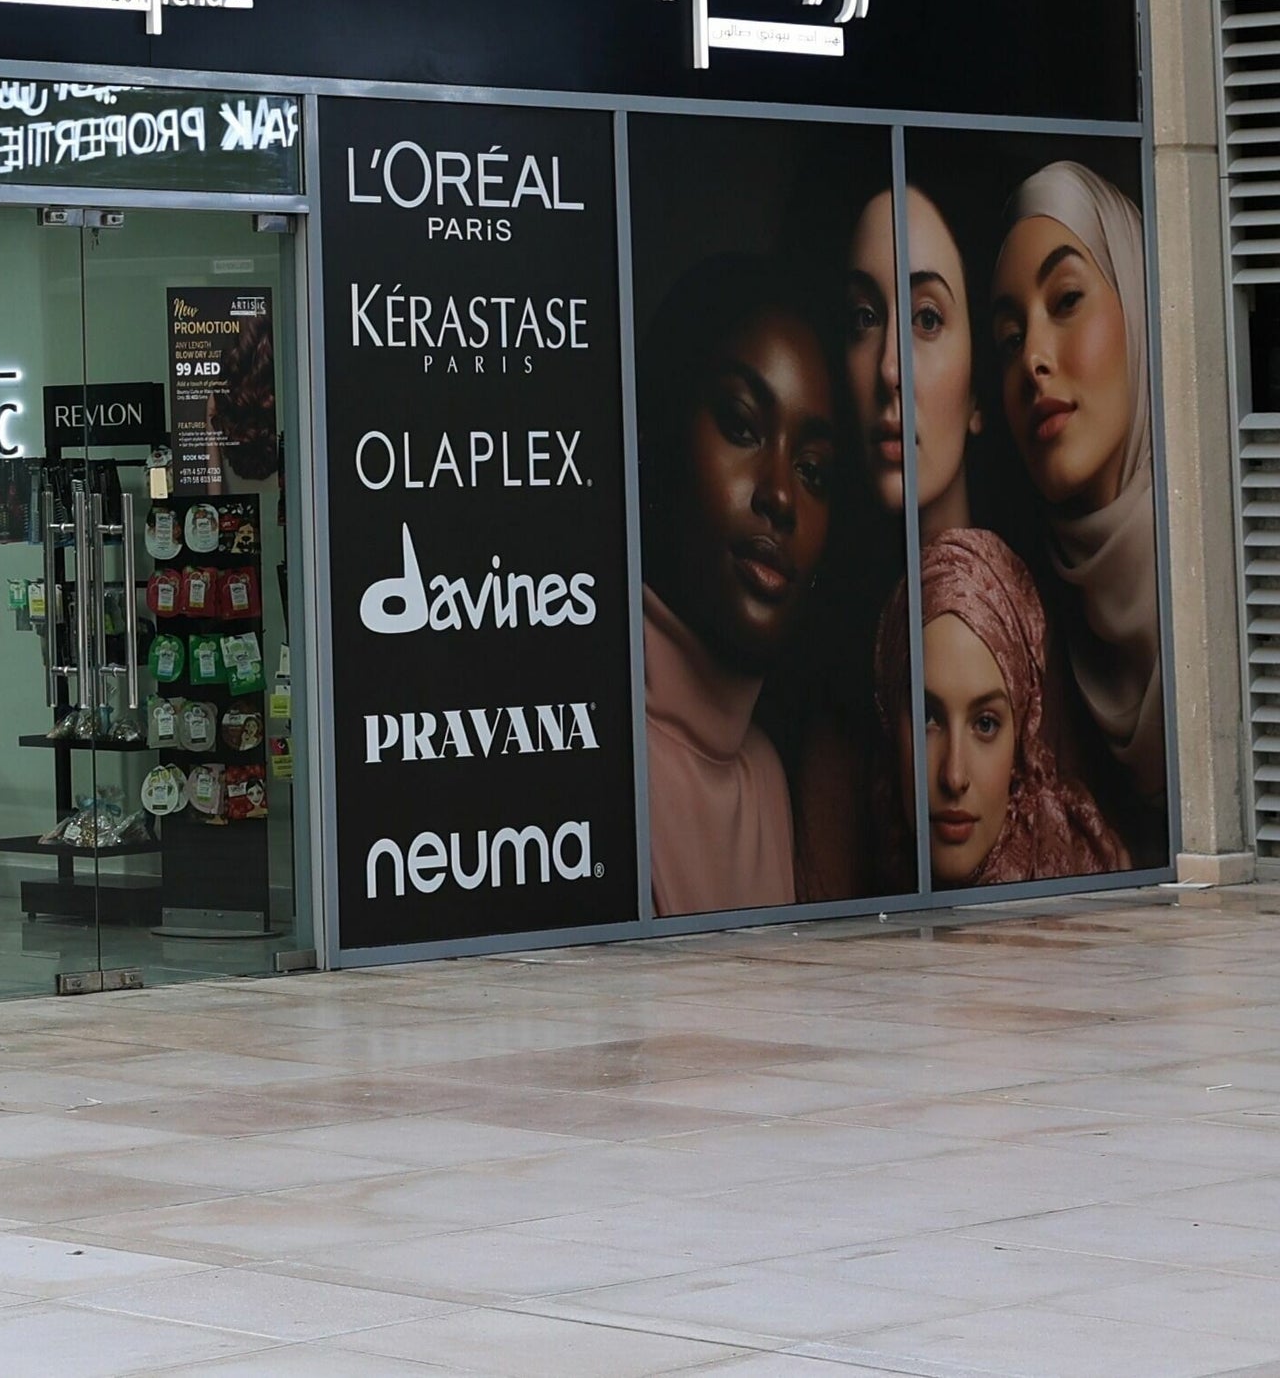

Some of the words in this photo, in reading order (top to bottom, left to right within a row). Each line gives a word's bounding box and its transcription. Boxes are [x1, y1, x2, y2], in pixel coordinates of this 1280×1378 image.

[173, 298, 199, 320] New
[352, 284, 588, 348] KÉRASTASE
[174, 321, 239, 334] PROMOTION
[176, 363, 191, 376] 99
[194, 362, 220, 375] AED
[425, 356, 532, 373] PARIS
[55, 403, 142, 428] REVLON
[360, 522, 596, 633] davines
